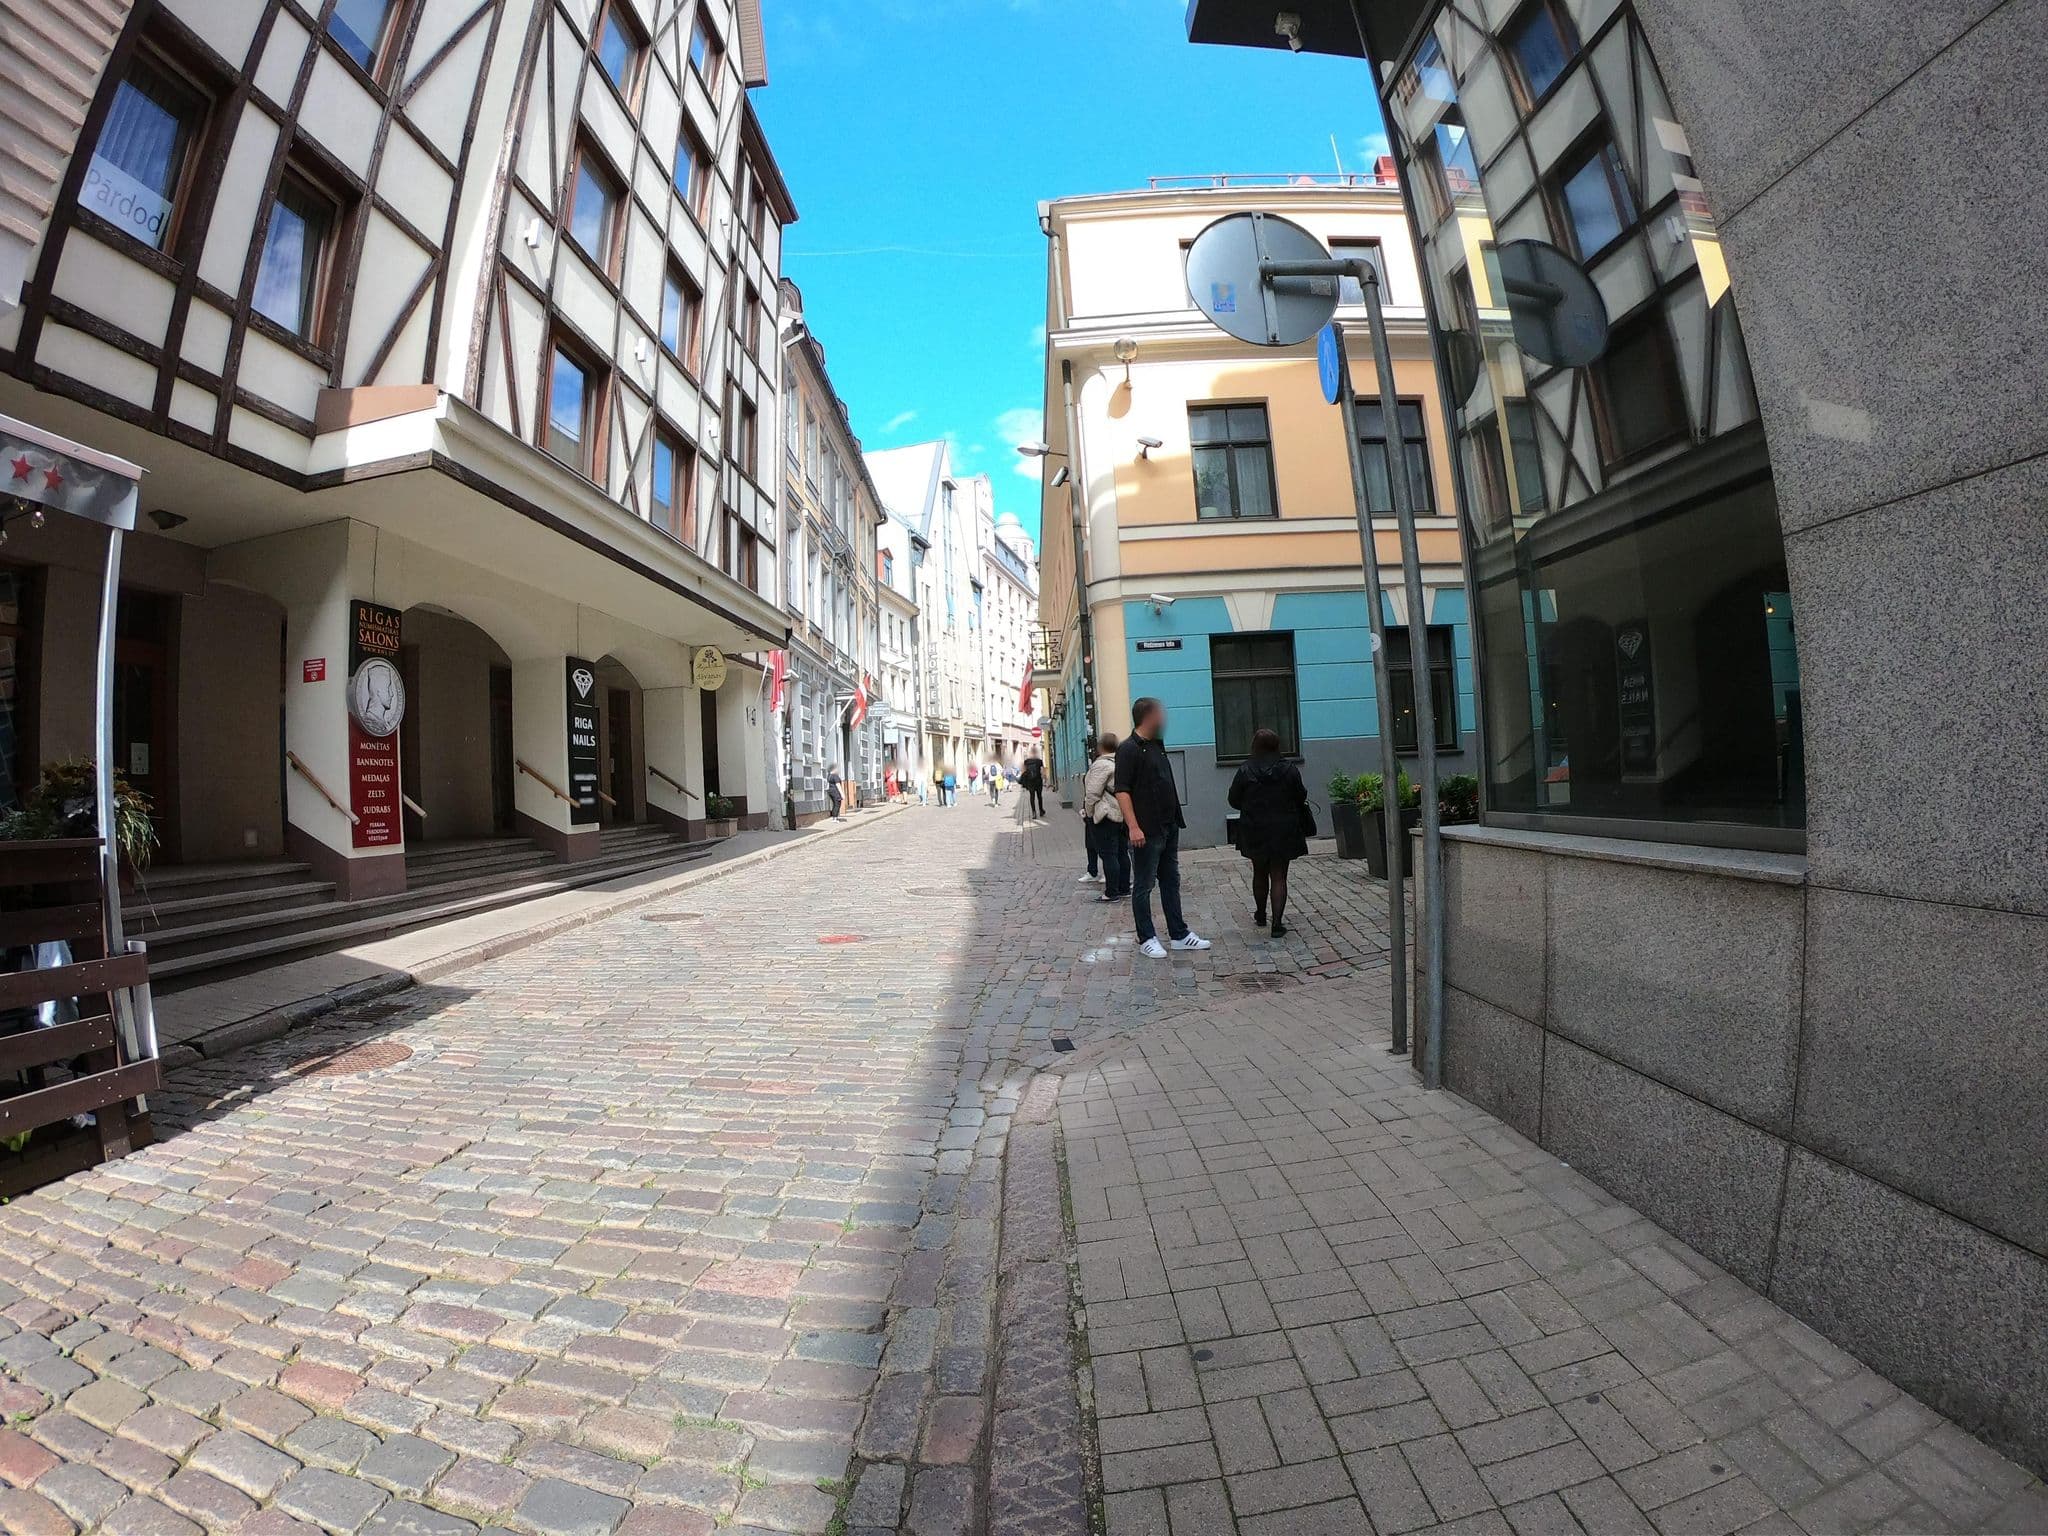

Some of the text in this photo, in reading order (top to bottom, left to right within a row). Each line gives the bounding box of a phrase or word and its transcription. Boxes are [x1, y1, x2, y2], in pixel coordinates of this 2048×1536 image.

[85, 168, 164, 235] Pārdod
[359, 629, 399, 649] SALONS
[928, 641, 939, 715] HOTEL
[574, 717, 593, 730] RIGA
[573, 734, 596, 747] NAILS
[356, 758, 394, 767] BANKNOTES
[368, 790, 385, 798] ZELTS
[363, 805, 391, 814] SUDRABS
